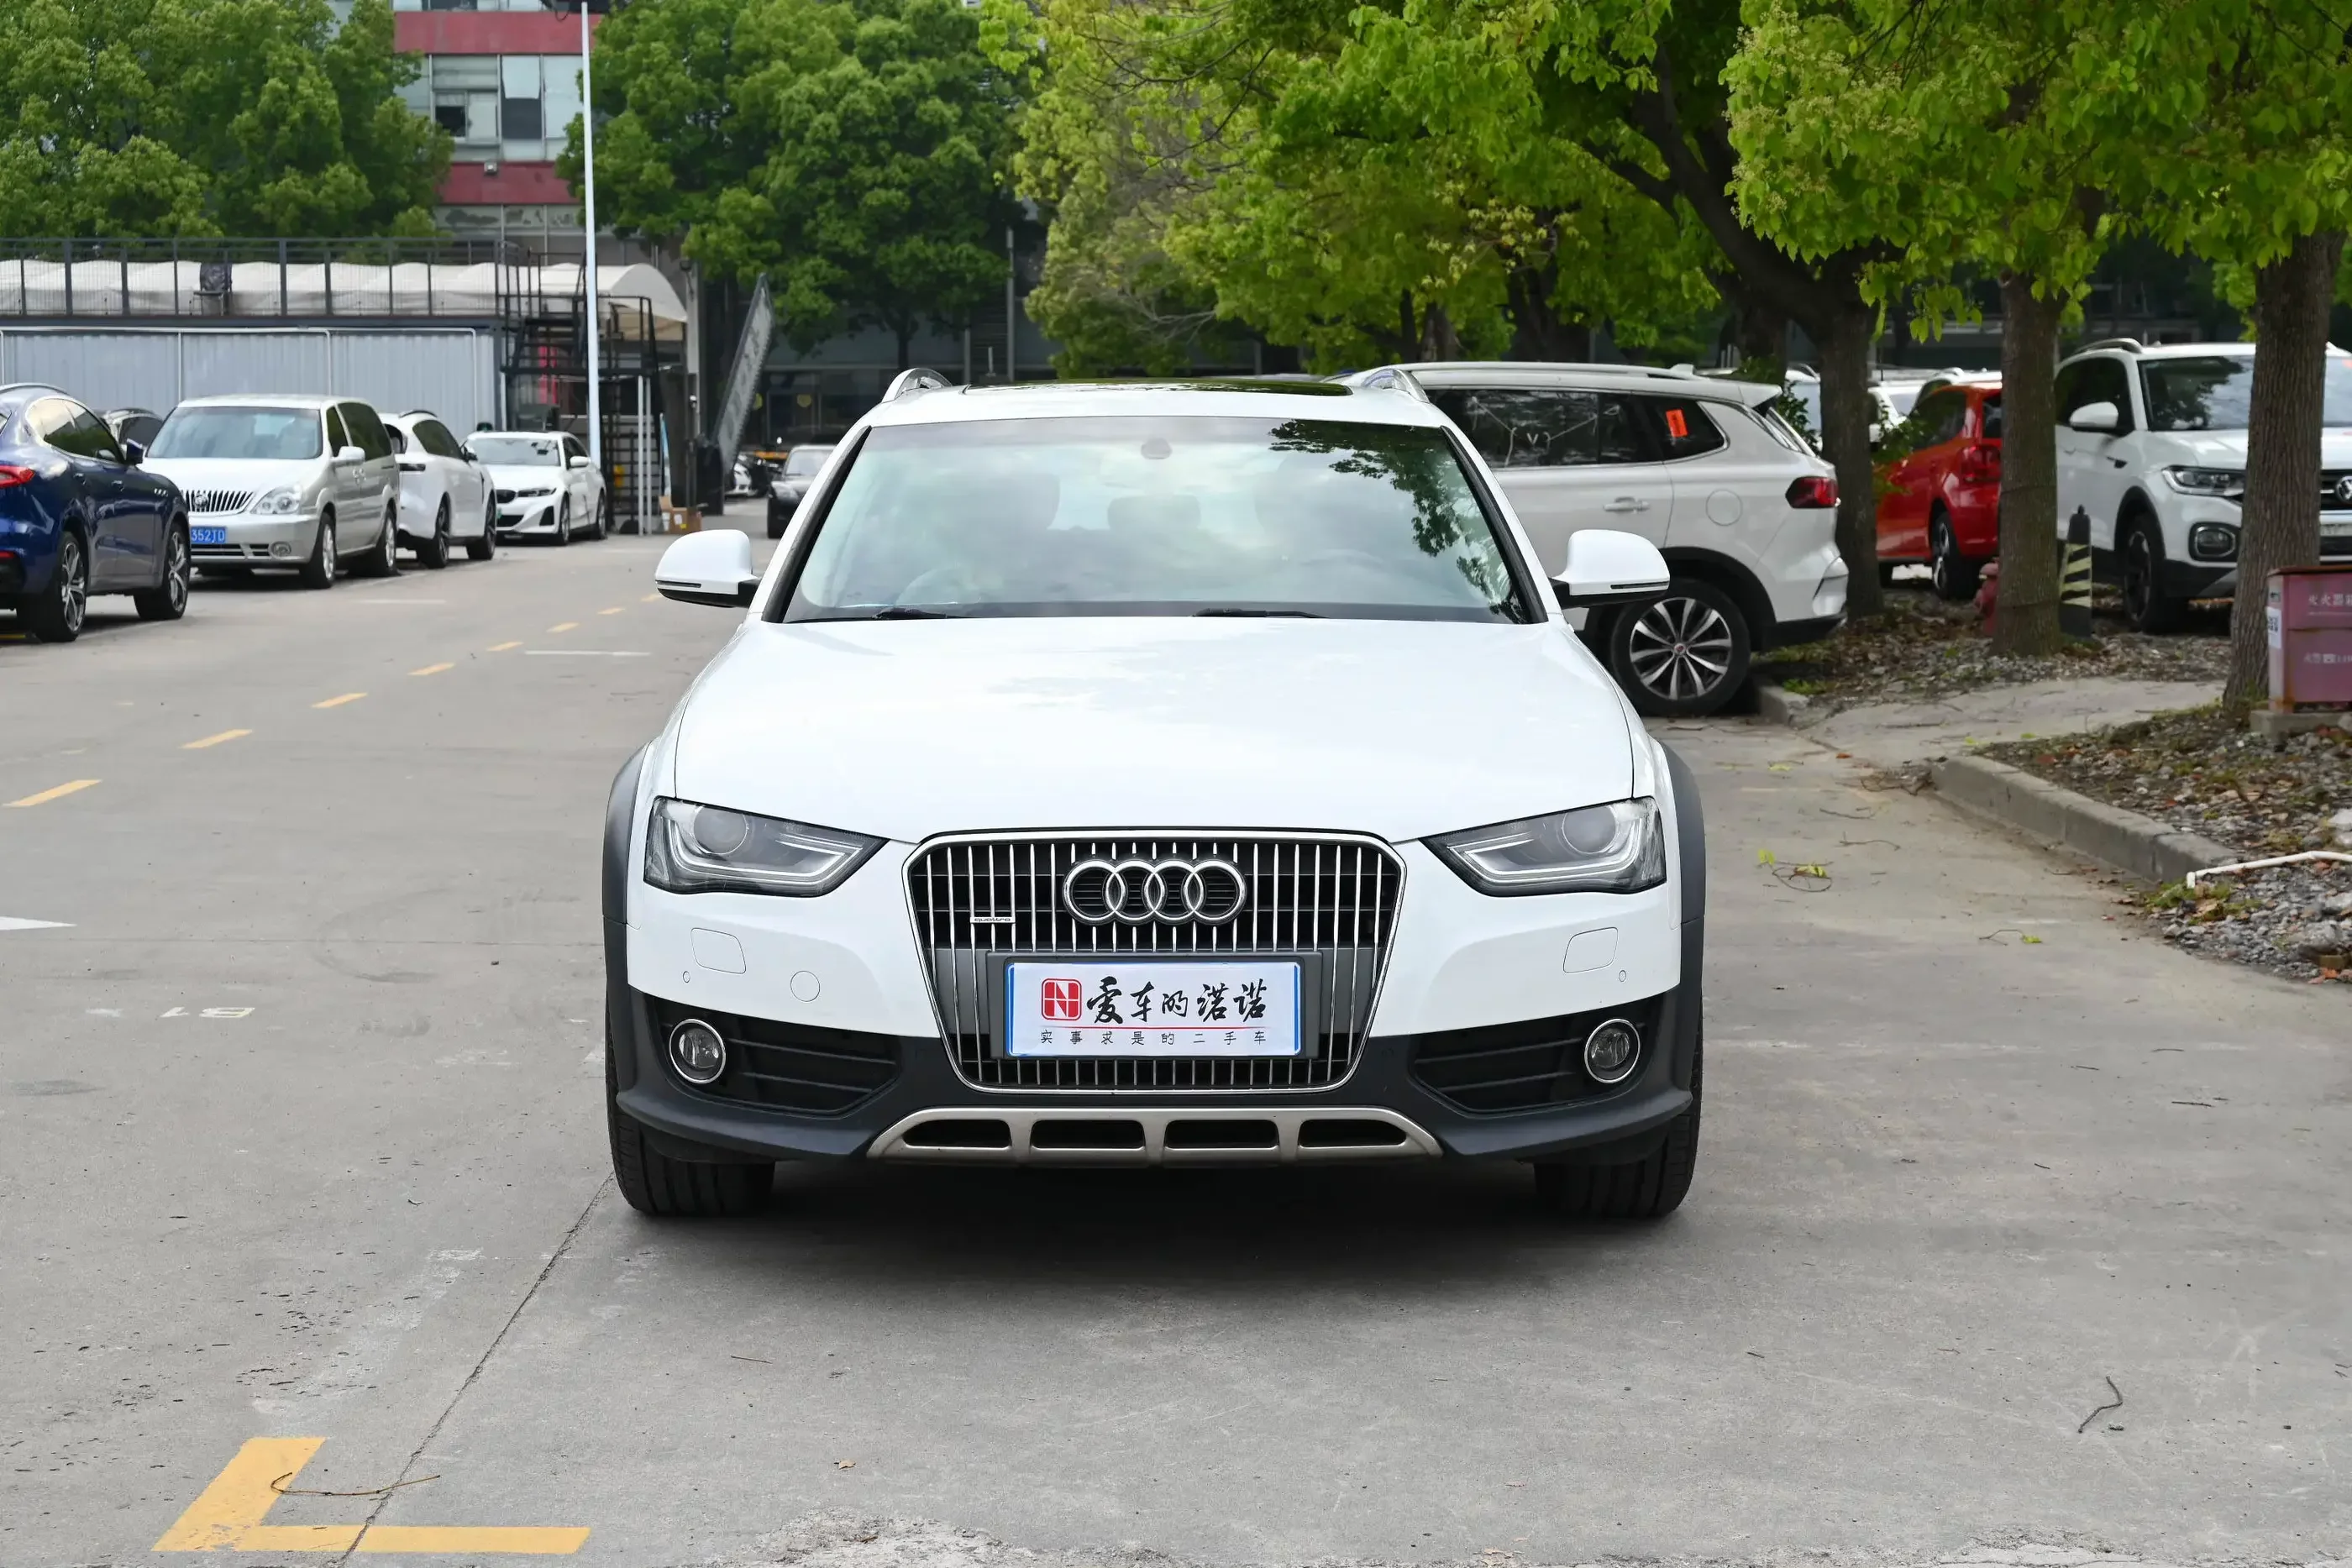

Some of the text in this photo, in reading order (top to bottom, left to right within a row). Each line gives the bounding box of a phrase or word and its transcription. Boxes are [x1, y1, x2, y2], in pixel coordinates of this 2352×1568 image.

[1041, 1030, 1266, 1045] 实事求是的二手车
